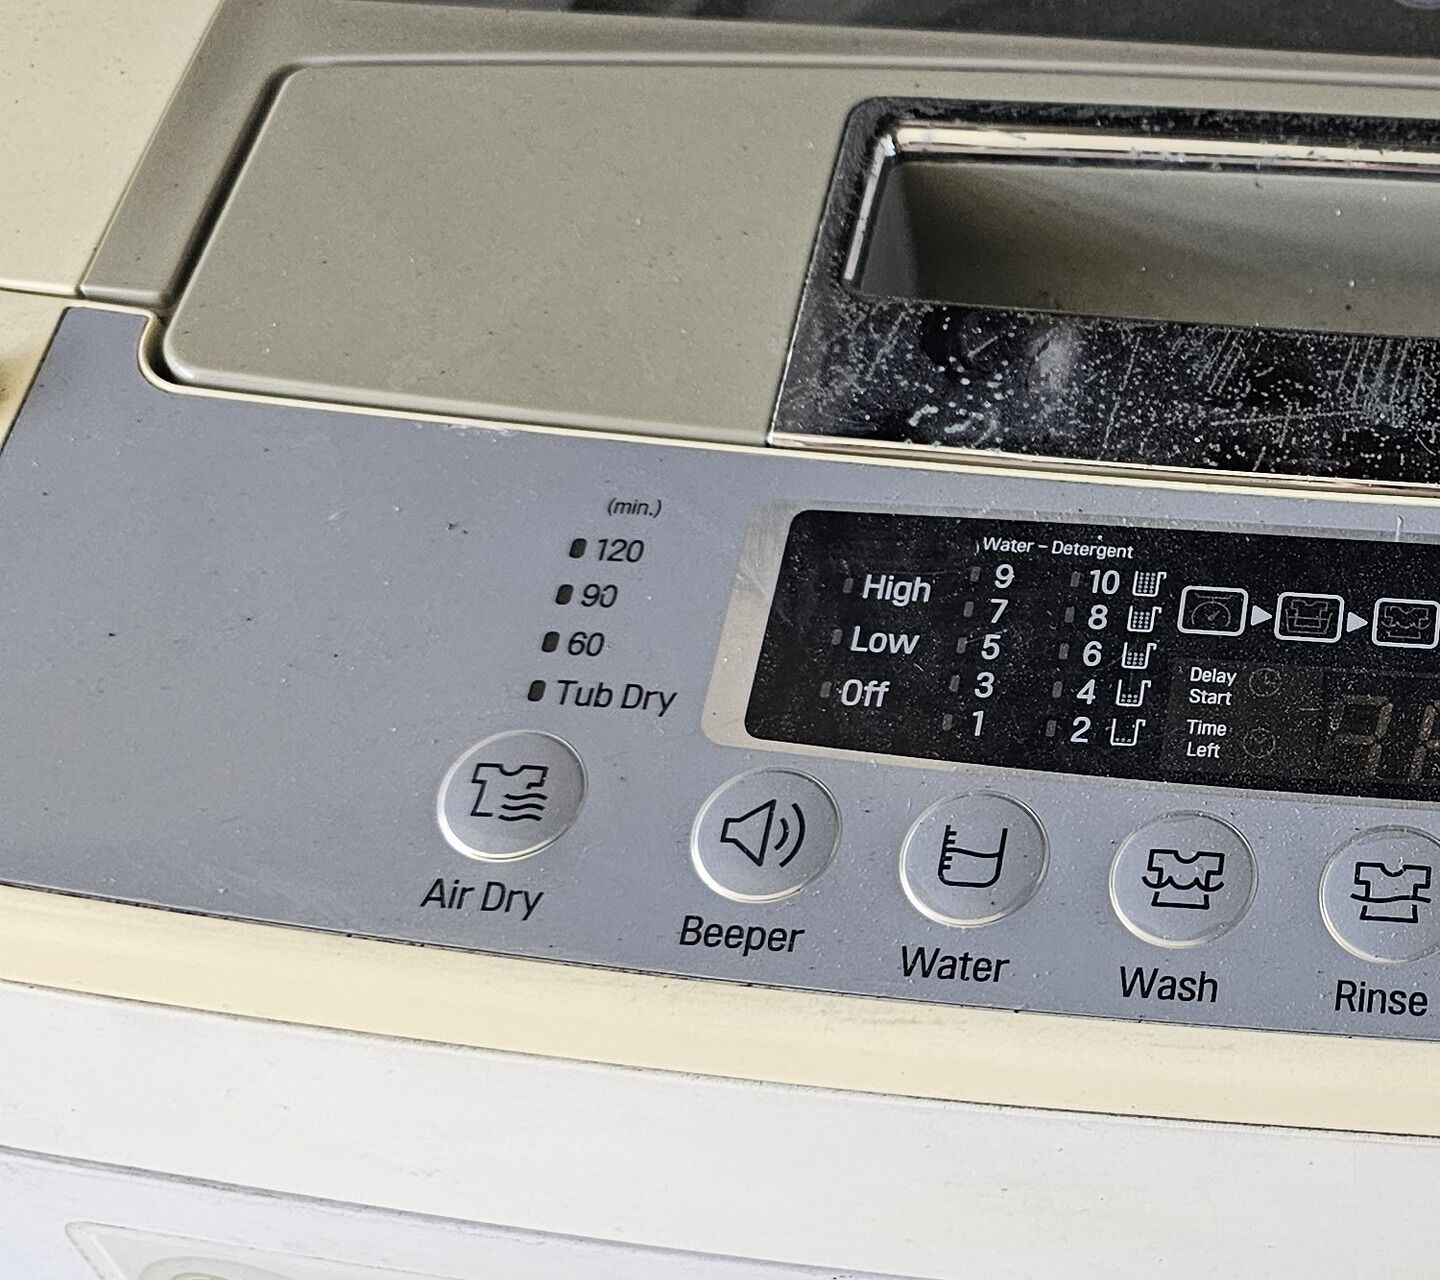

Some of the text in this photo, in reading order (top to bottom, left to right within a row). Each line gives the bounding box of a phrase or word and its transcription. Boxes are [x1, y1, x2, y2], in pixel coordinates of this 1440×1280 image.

[607, 497, 662, 518] (min.)
[597, 539, 644, 563] 120
[982, 537, 1035, 553] Water
[1051, 541, 1134, 559] Detergent
[994, 564, 1015, 588] 9
[1089, 570, 1120, 595] 10
[581, 583, 618, 608] 90
[862, 574, 931, 607] High
[990, 599, 1008, 623] 7
[1087, 605, 1108, 630] 8
[567, 631, 605, 656] 60
[850, 626, 920, 655] Low
[981, 634, 1001, 660] 5
[1082, 641, 1103, 666] 6
[974, 672, 995, 698] 3
[1189, 667, 1237, 687] Delay
[557, 679, 678, 717] Tub Dry
[840, 679, 890, 708] Off
[1076, 679, 1096, 705] 4
[1189, 687, 1232, 706] Start
[972, 710, 985, 736] 1
[1070, 717, 1091, 743] 2
[1186, 718, 1227, 737] Time
[1186, 741, 1220, 758] Left
[420, 878, 544, 921] Air Dry
[679, 916, 806, 954] Beeper
[900, 945, 1010, 985] Water
[1119, 966, 1219, 1004] Wash
[1334, 980, 1429, 1018] Rinse
